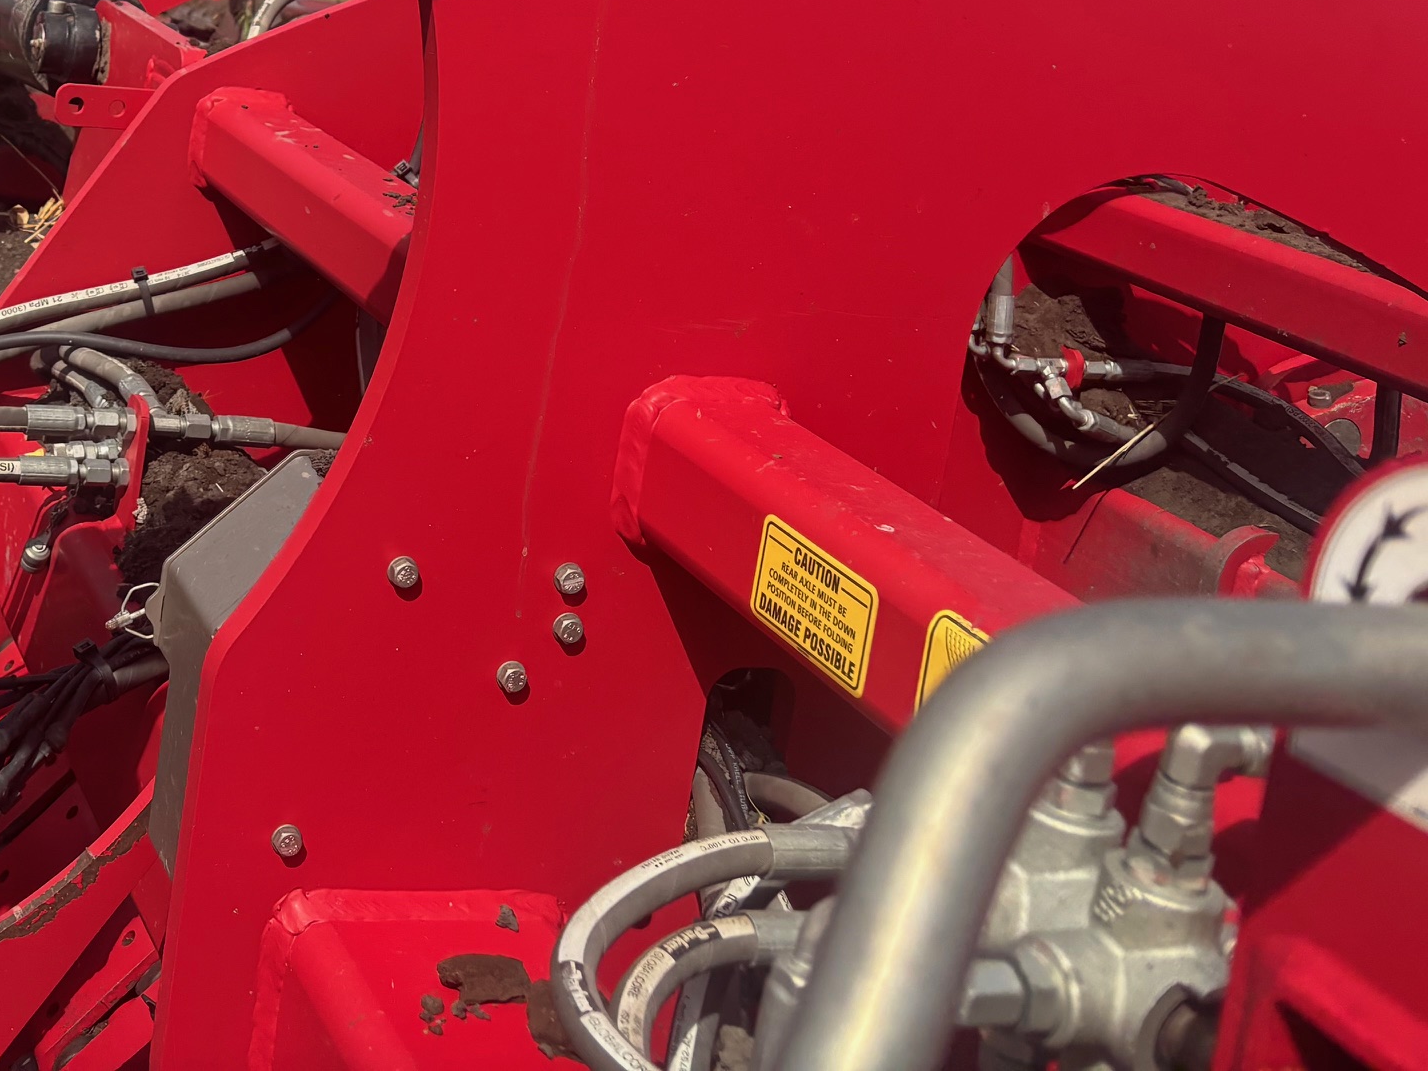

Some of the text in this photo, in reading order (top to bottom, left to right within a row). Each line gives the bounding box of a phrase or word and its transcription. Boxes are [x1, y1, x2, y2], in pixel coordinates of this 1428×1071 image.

[1, 304, 27, 317] (3000
[28, 298, 50, 309] MPa
[51, 296, 63, 305] 21
[781, 562, 847, 618] REAR AXLE MUST BE
[794, 547, 840, 594] CAUTION
[767, 581, 853, 654] POSITION BEFORE FOLDING
[769, 568, 856, 640] COMPLETELY IN THE DOWN
[759, 592, 856, 681] DAMAGE POSSIBLE
[663, 926, 710, 953] Parker
